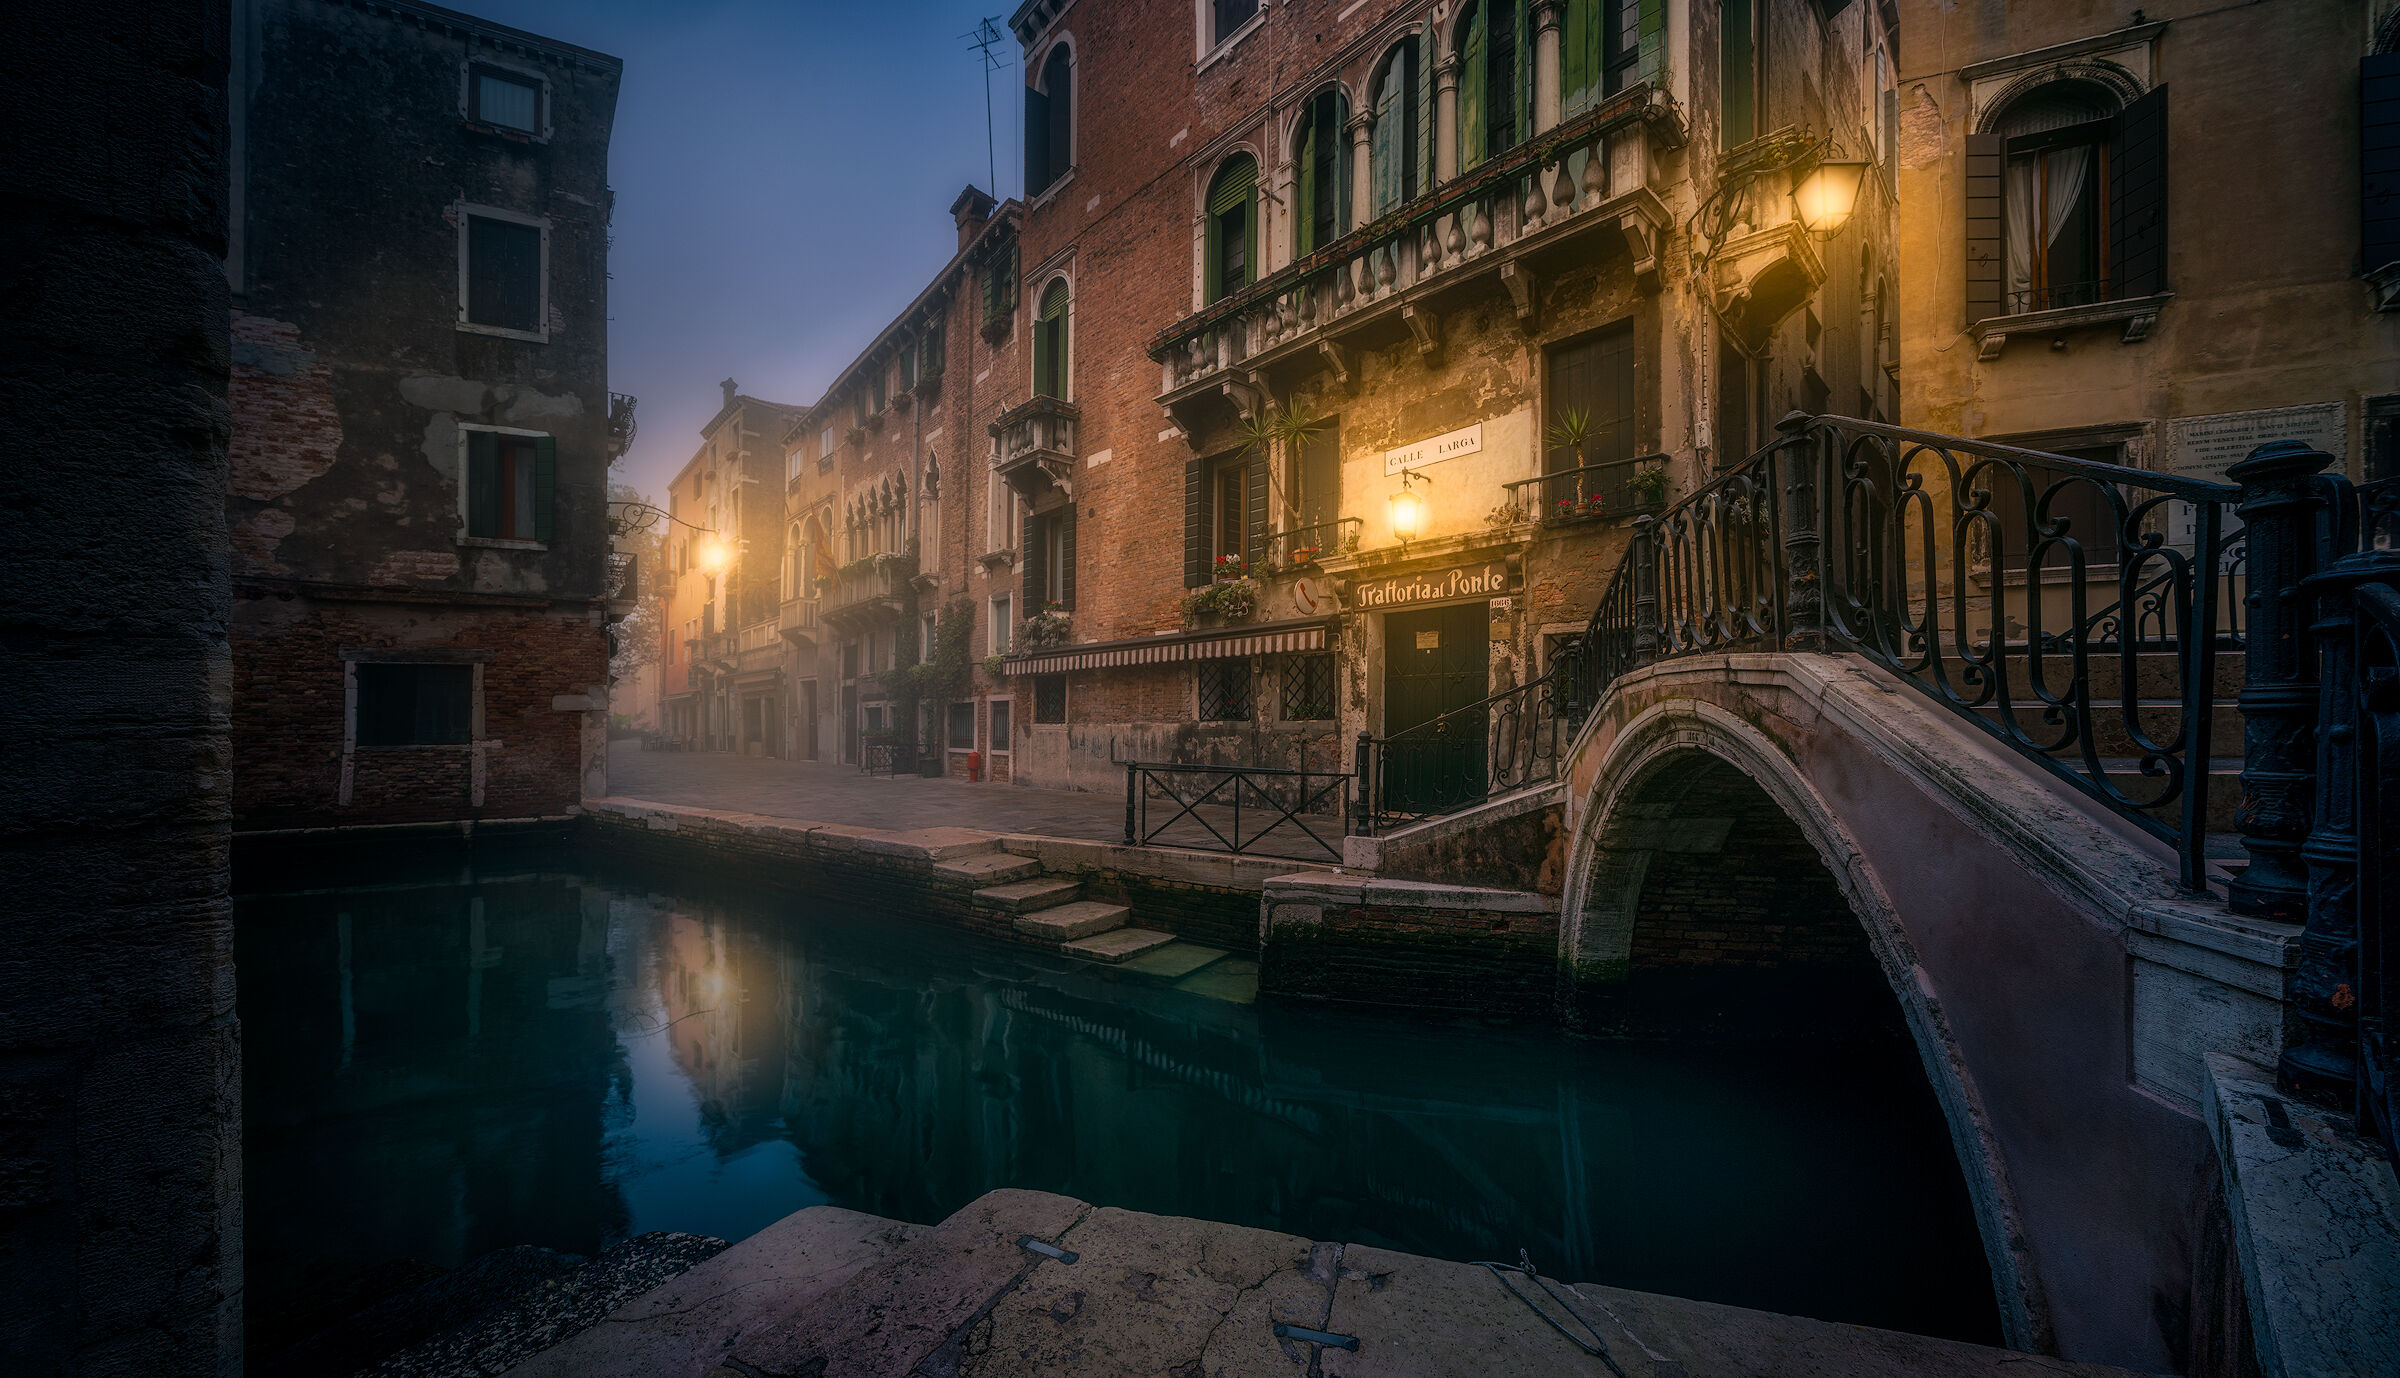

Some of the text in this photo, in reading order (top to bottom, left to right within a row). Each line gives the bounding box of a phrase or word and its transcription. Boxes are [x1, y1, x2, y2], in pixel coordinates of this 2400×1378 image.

[1389, 437, 1475, 466] CALLE LARGA
[1357, 565, 1504, 607] Trattoria al Ponte
